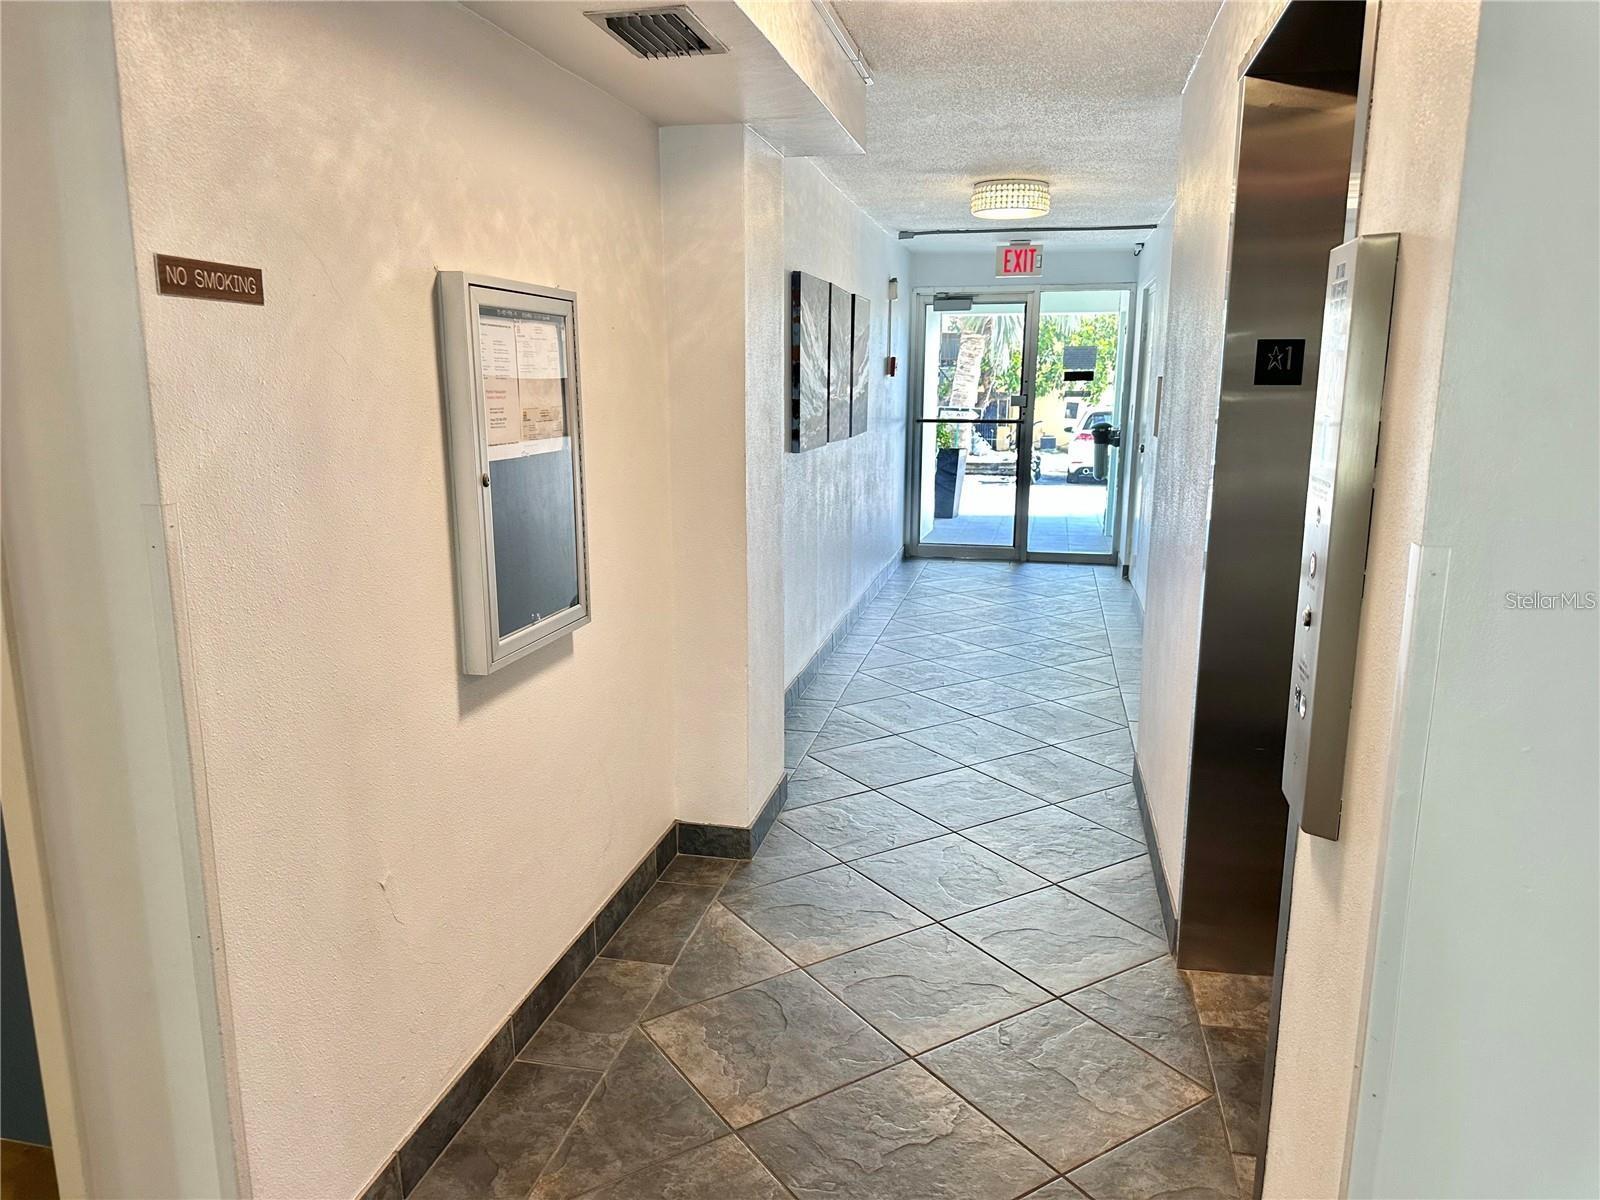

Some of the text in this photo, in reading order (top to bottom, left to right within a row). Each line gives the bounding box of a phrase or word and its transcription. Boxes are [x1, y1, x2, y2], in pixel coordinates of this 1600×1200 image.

[1003, 248, 1037, 273] EXIT
[165, 264, 257, 295] NO SMOKING
